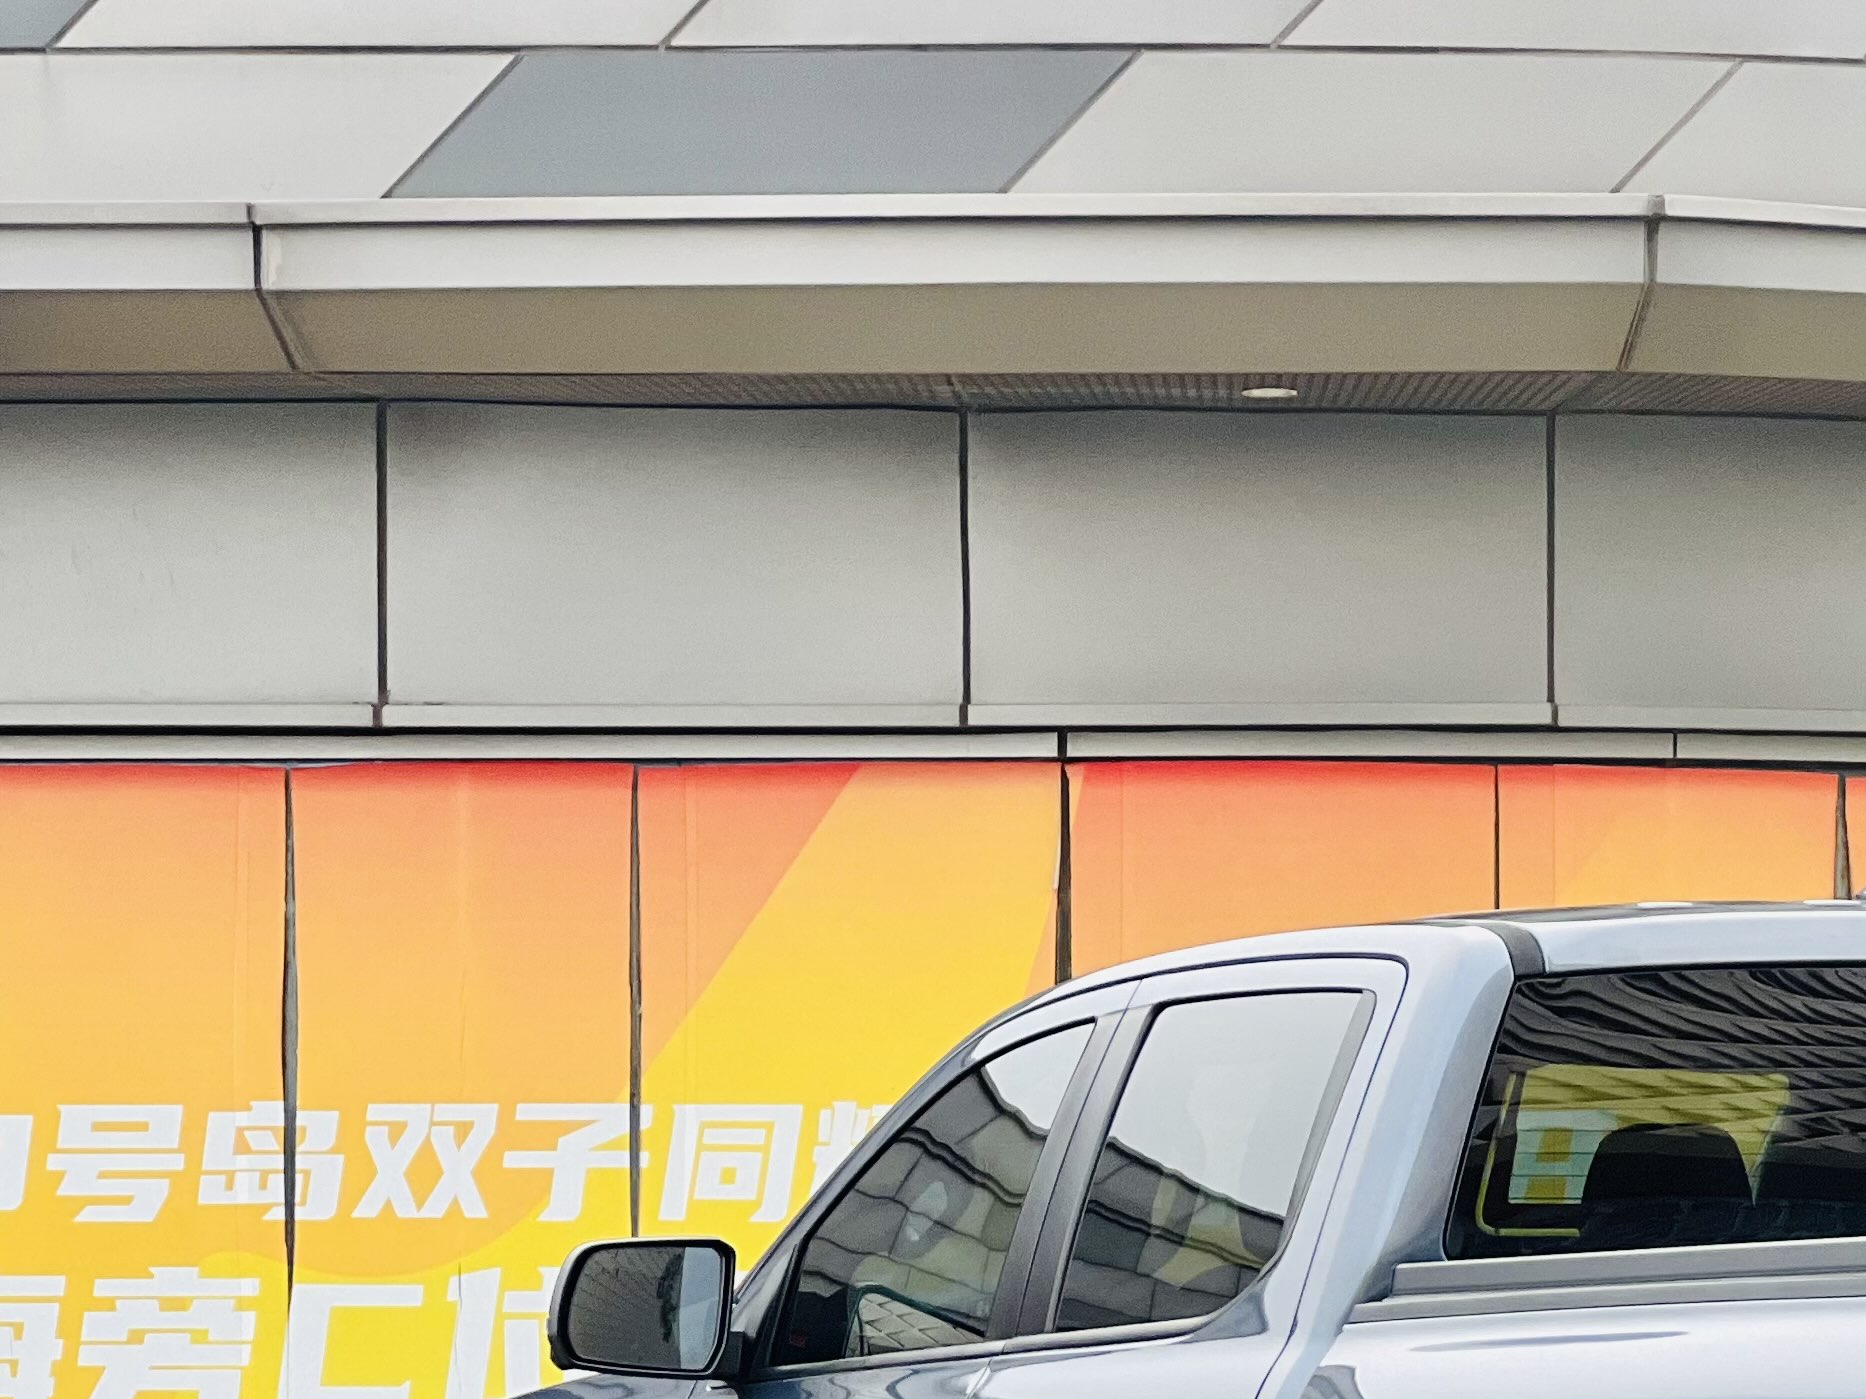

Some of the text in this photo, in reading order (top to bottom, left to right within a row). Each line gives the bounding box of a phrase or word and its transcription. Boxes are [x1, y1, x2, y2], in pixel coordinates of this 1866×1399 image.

[0, 1100, 895, 1223] 号岛双子同
